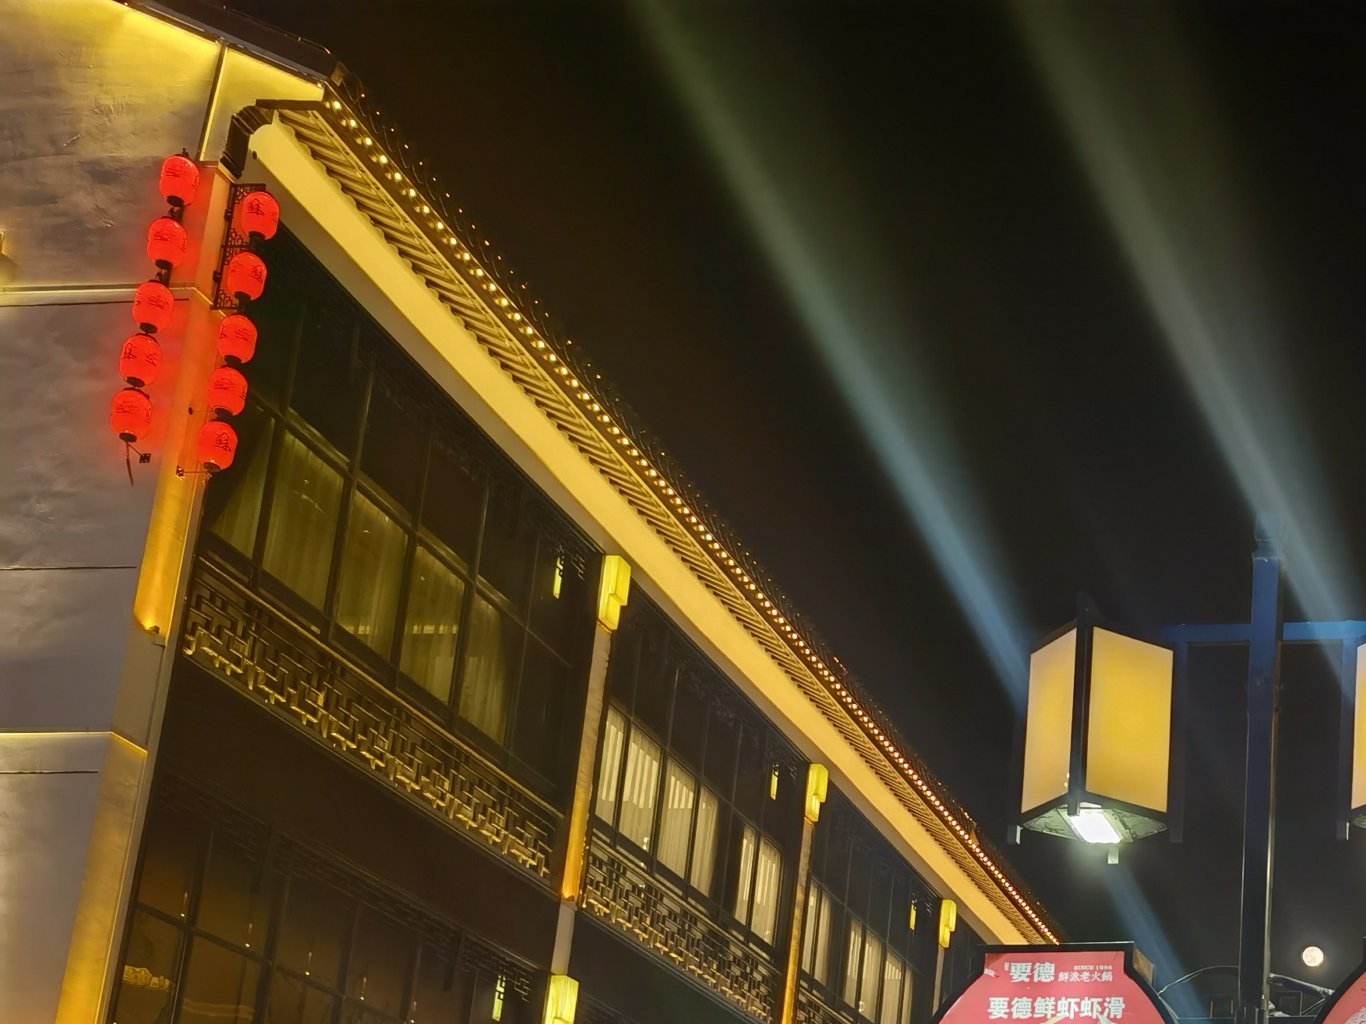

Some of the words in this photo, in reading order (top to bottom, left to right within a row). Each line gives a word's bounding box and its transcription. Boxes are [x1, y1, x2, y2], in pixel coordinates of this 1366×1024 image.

[1009, 962, 1055, 982] 要德
[987, 997, 1125, 1019] 要德鲜虾虾滑
